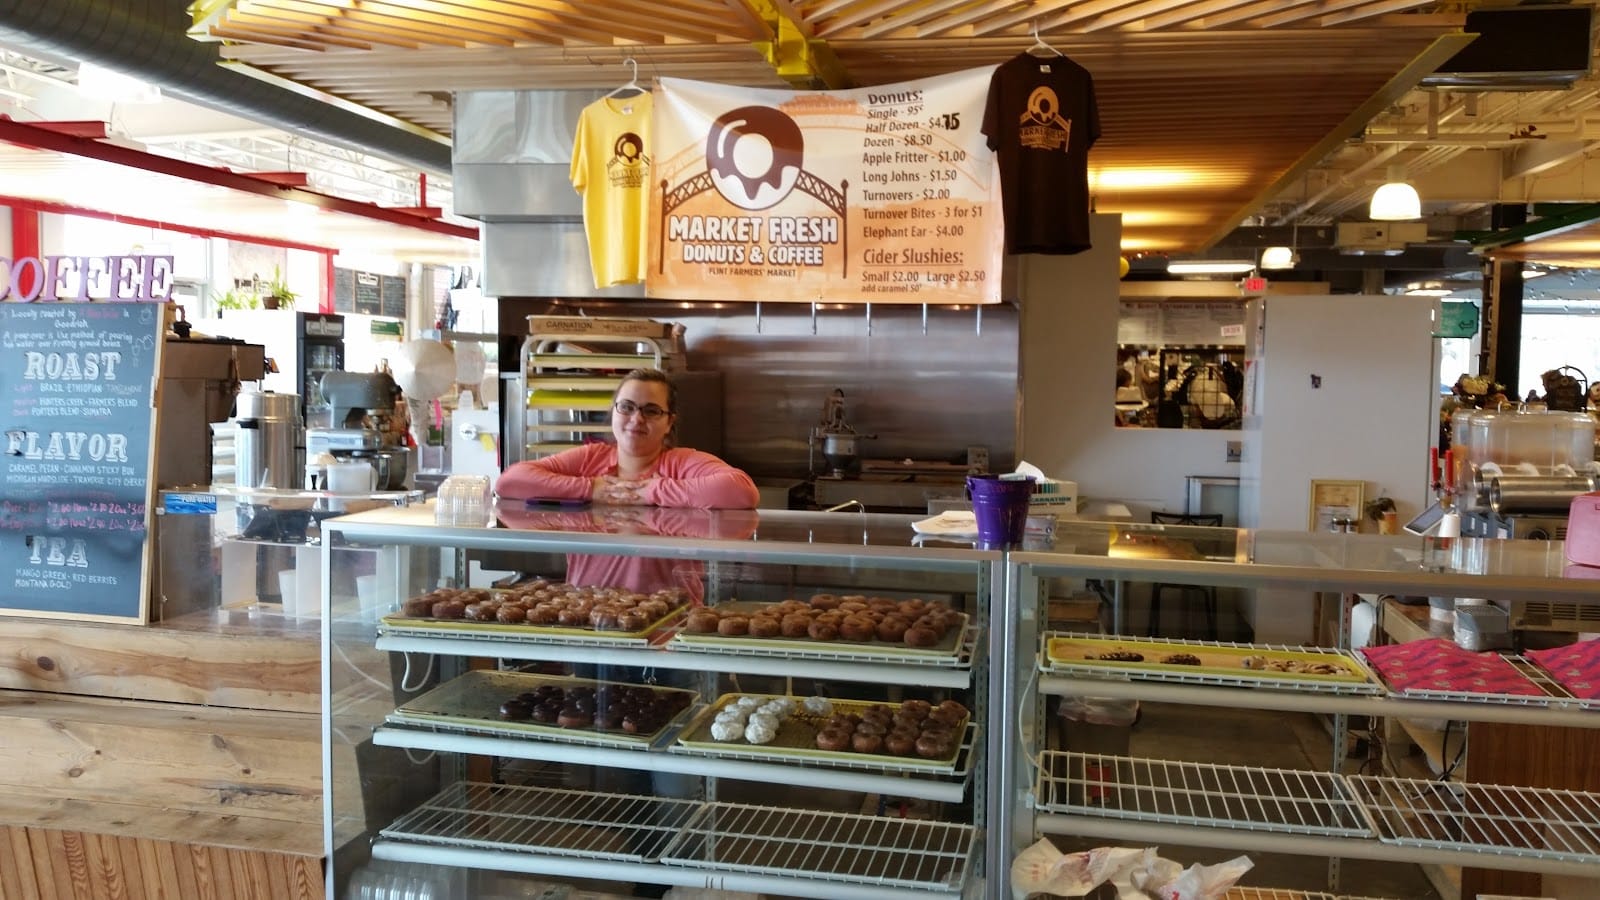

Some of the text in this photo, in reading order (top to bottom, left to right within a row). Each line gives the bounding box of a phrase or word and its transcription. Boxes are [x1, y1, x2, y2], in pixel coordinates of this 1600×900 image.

[868, 90, 924, 104] Donuts:
[867, 108, 898, 119] Single
[866, 123, 887, 133] Half
[890, 121, 919, 131] Dozen
[863, 137, 894, 147] Dozen
[903, 135, 932, 146] $8.50
[863, 152, 892, 166] Apple
[895, 152, 928, 163] Fritter
[938, 151, 966, 162] $1.00
[863, 171, 888, 184] Long
[891, 170, 920, 182] Johns
[930, 170, 957, 181] $1.50
[863, 190, 913, 201] Turnovers
[923, 189, 950, 200] $2.00
[863, 208, 908, 219] Turnover
[911, 208, 936, 219] Bites
[944, 207, 951, 218] 3
[954, 207, 969, 217] for
[971, 206, 983, 217] $1
[669, 215, 838, 243] MARKET FRESH
[863, 226, 909, 240] Elephant
[911, 227, 926, 237] Ear
[936, 225, 964, 236] $4.00
[683, 244, 823, 265] DONUTS & COFFEE
[863, 249, 964, 264] Cider Slushies:
[709, 267, 796, 277] FLINT FARMERS' MARKET
[862, 270, 986, 284] Small $2.00 Large $2.50
[861, 284, 876, 292] add
[878, 284, 909, 292] caramel
[546, 321, 593, 330] CARNATION
[57, 331, 68, 340] the
[23, 351, 122, 381] ROAST
[4, 430, 129, 463] FLAVOR
[9, 463, 39, 474] CARAMEL
[39, 464, 60, 474] PECAN
[64, 464, 96, 474] CINNAMON
[121, 466, 135, 476] BUN
[107, 477, 122, 487] CITY
[27, 535, 89, 568] TEA
[15, 568, 41, 579] MANGO
[42, 570, 67, 580] GREEN
[72, 573, 87, 582] RED
[89, 575, 118, 585] BERRIES
[15, 579, 72, 590] MONTANA GOLD
